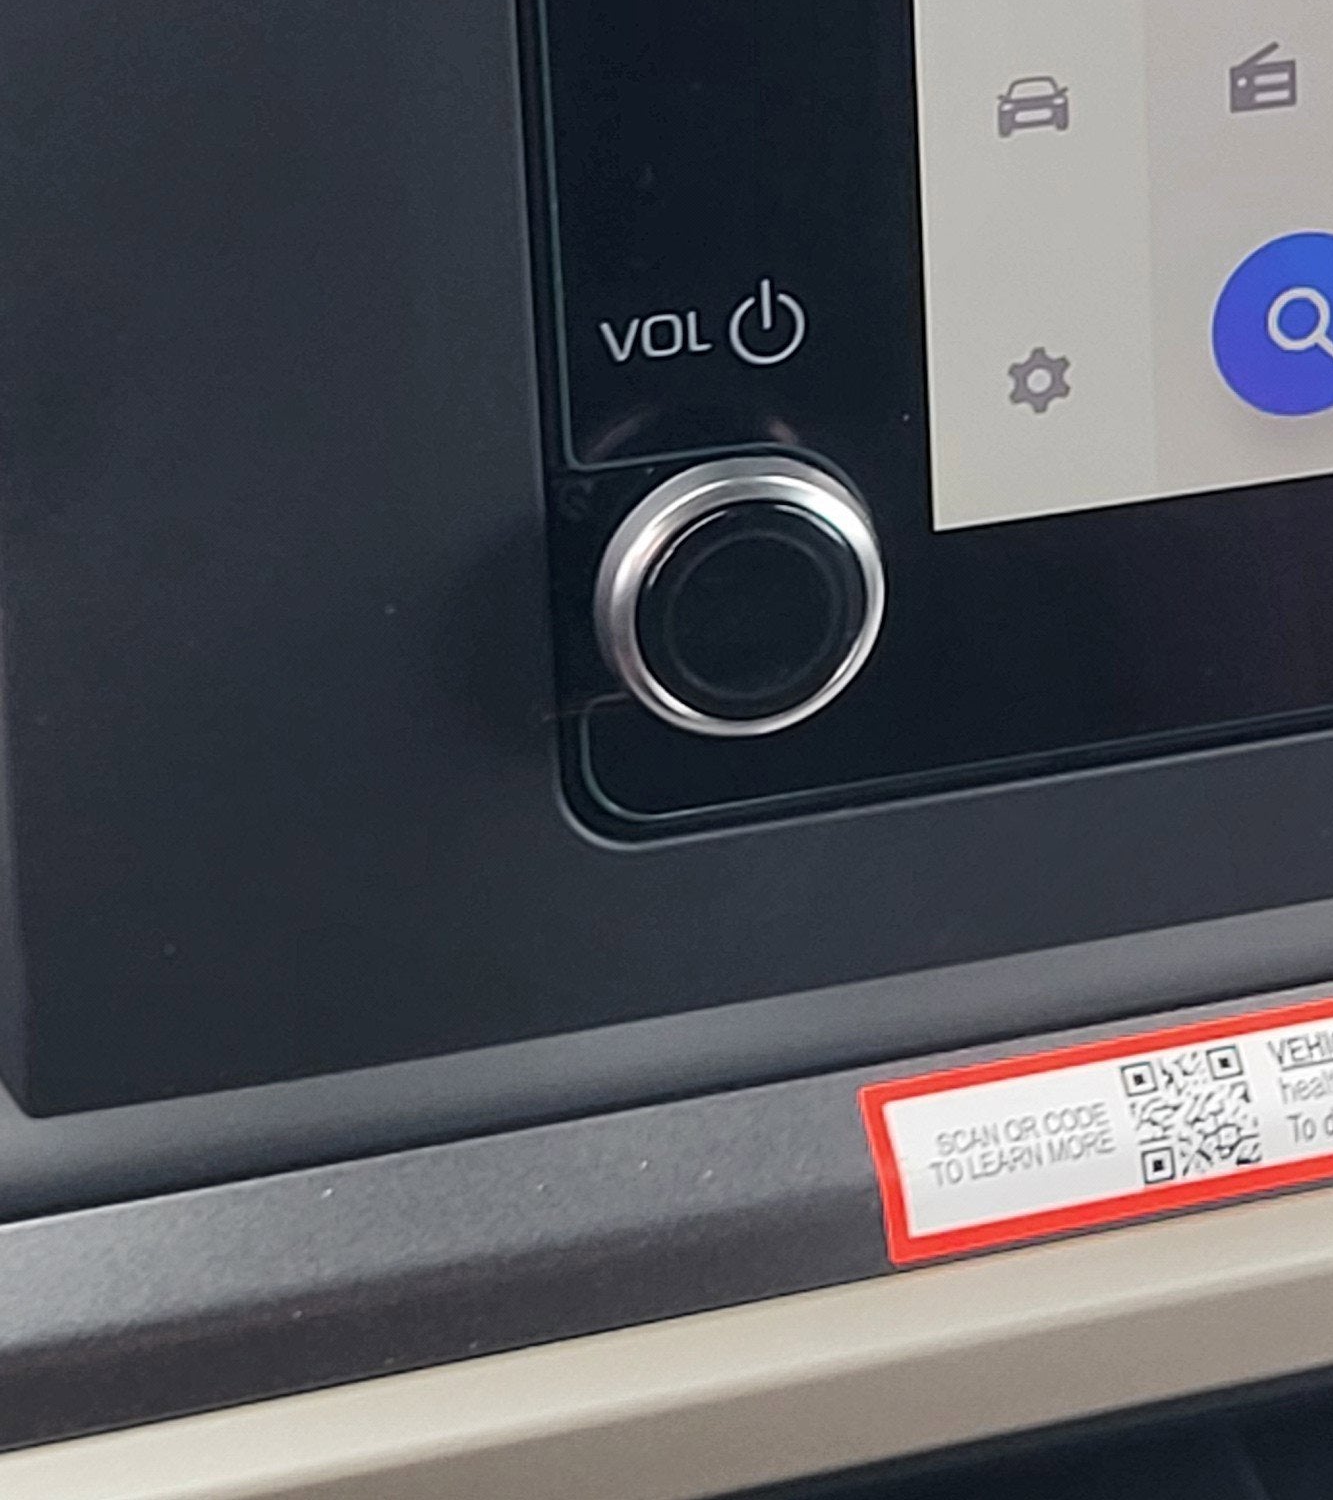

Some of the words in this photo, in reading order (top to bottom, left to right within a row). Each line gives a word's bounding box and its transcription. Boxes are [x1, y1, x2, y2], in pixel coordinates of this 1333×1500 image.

[601, 311, 712, 362] VOL
[935, 1121, 999, 1156] SCAN
[1043, 1102, 1110, 1136] CODE
[1286, 1113, 1317, 1143] To
[929, 1160, 965, 1188] TO
[968, 1140, 1043, 1181] LEARN
[1049, 1129, 1117, 1164] MORE
